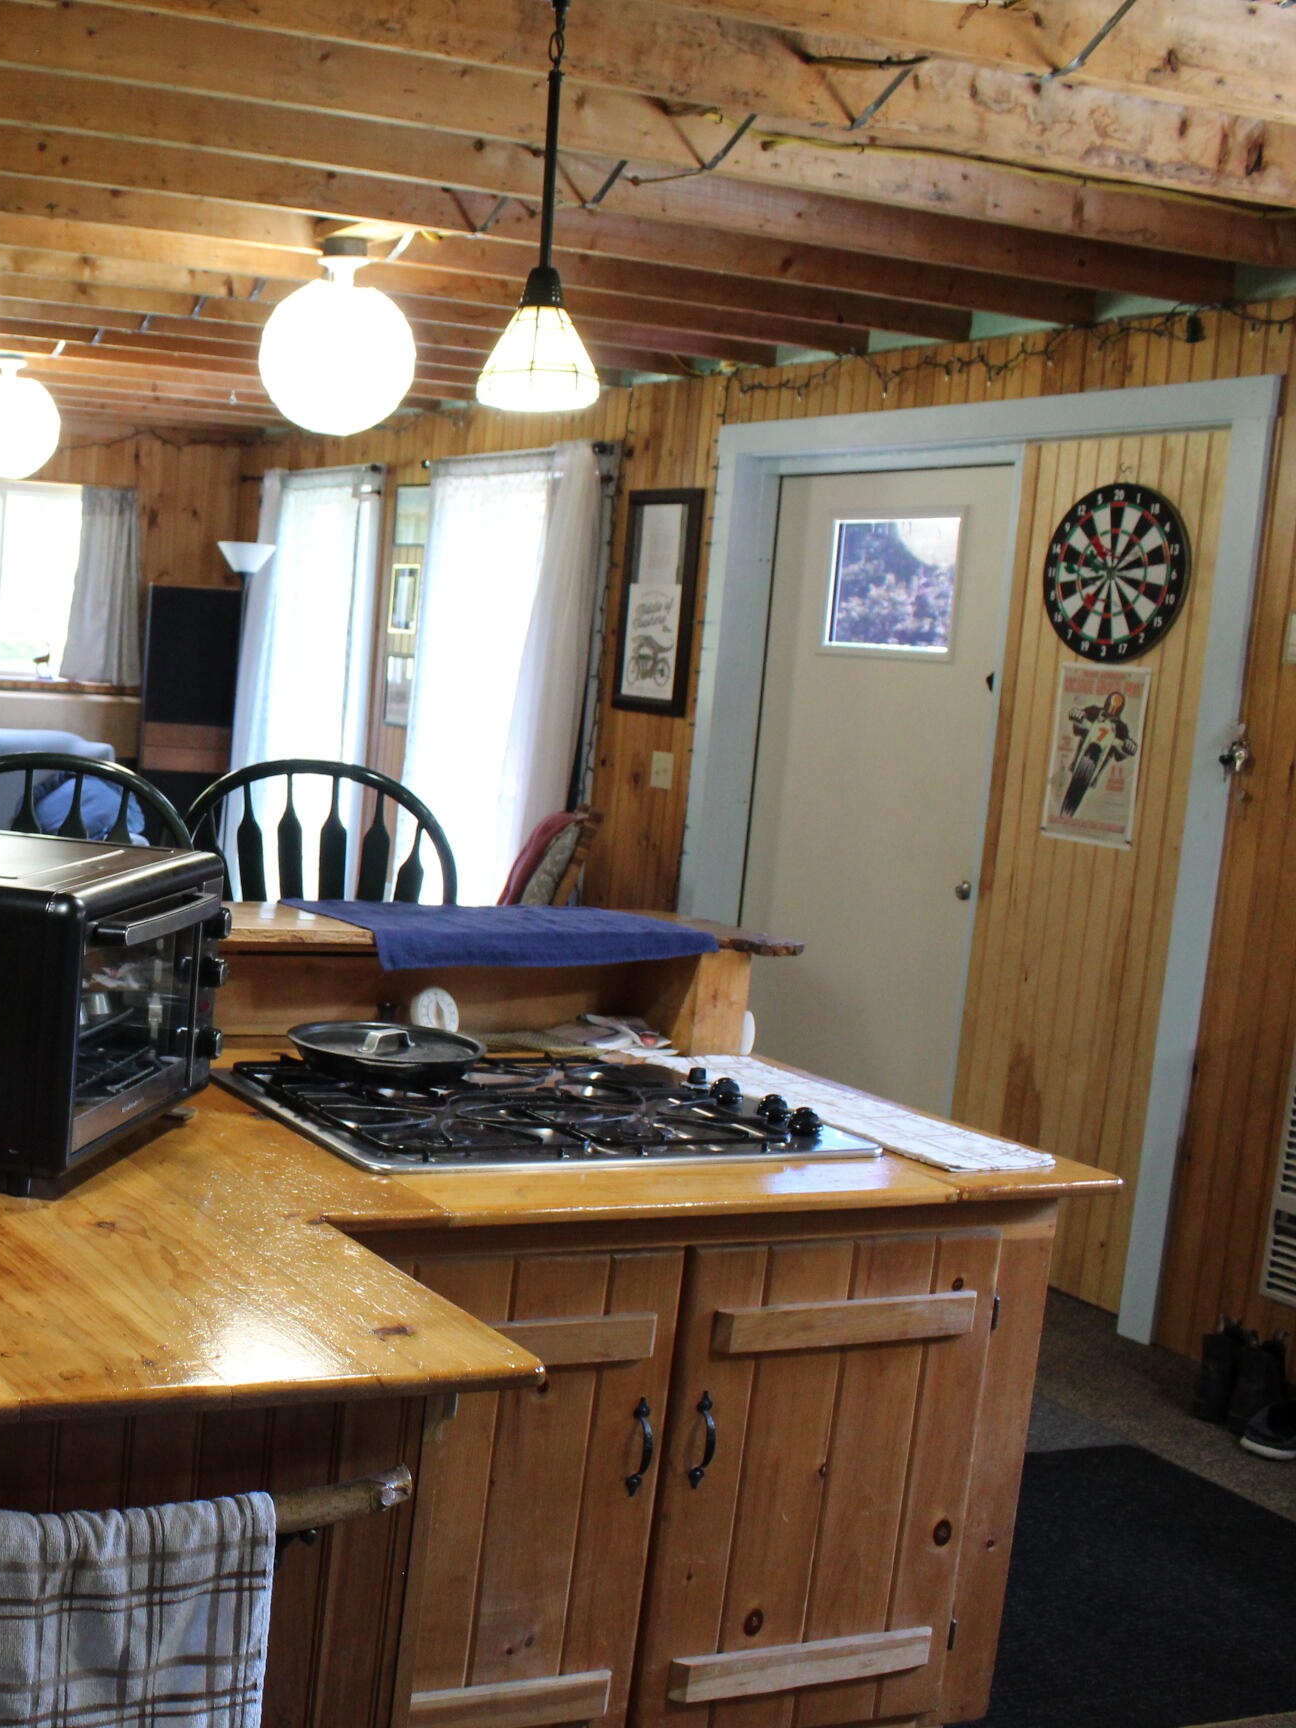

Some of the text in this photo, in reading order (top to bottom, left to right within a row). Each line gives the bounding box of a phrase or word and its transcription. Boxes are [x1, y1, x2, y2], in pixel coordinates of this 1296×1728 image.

[1113, 488, 1125, 501] 20
[1150, 502, 1161, 515] 18
[1052, 543, 1062, 555] 14
[1169, 543, 1180, 555] 13
[1164, 593, 1176, 605] 10
[1054, 611, 1064, 622] 16
[1153, 616, 1163, 628] 15
[1080, 639, 1090, 652] 19
[1118, 642, 1128, 654] 17
[1095, 727, 1110, 742] 7
